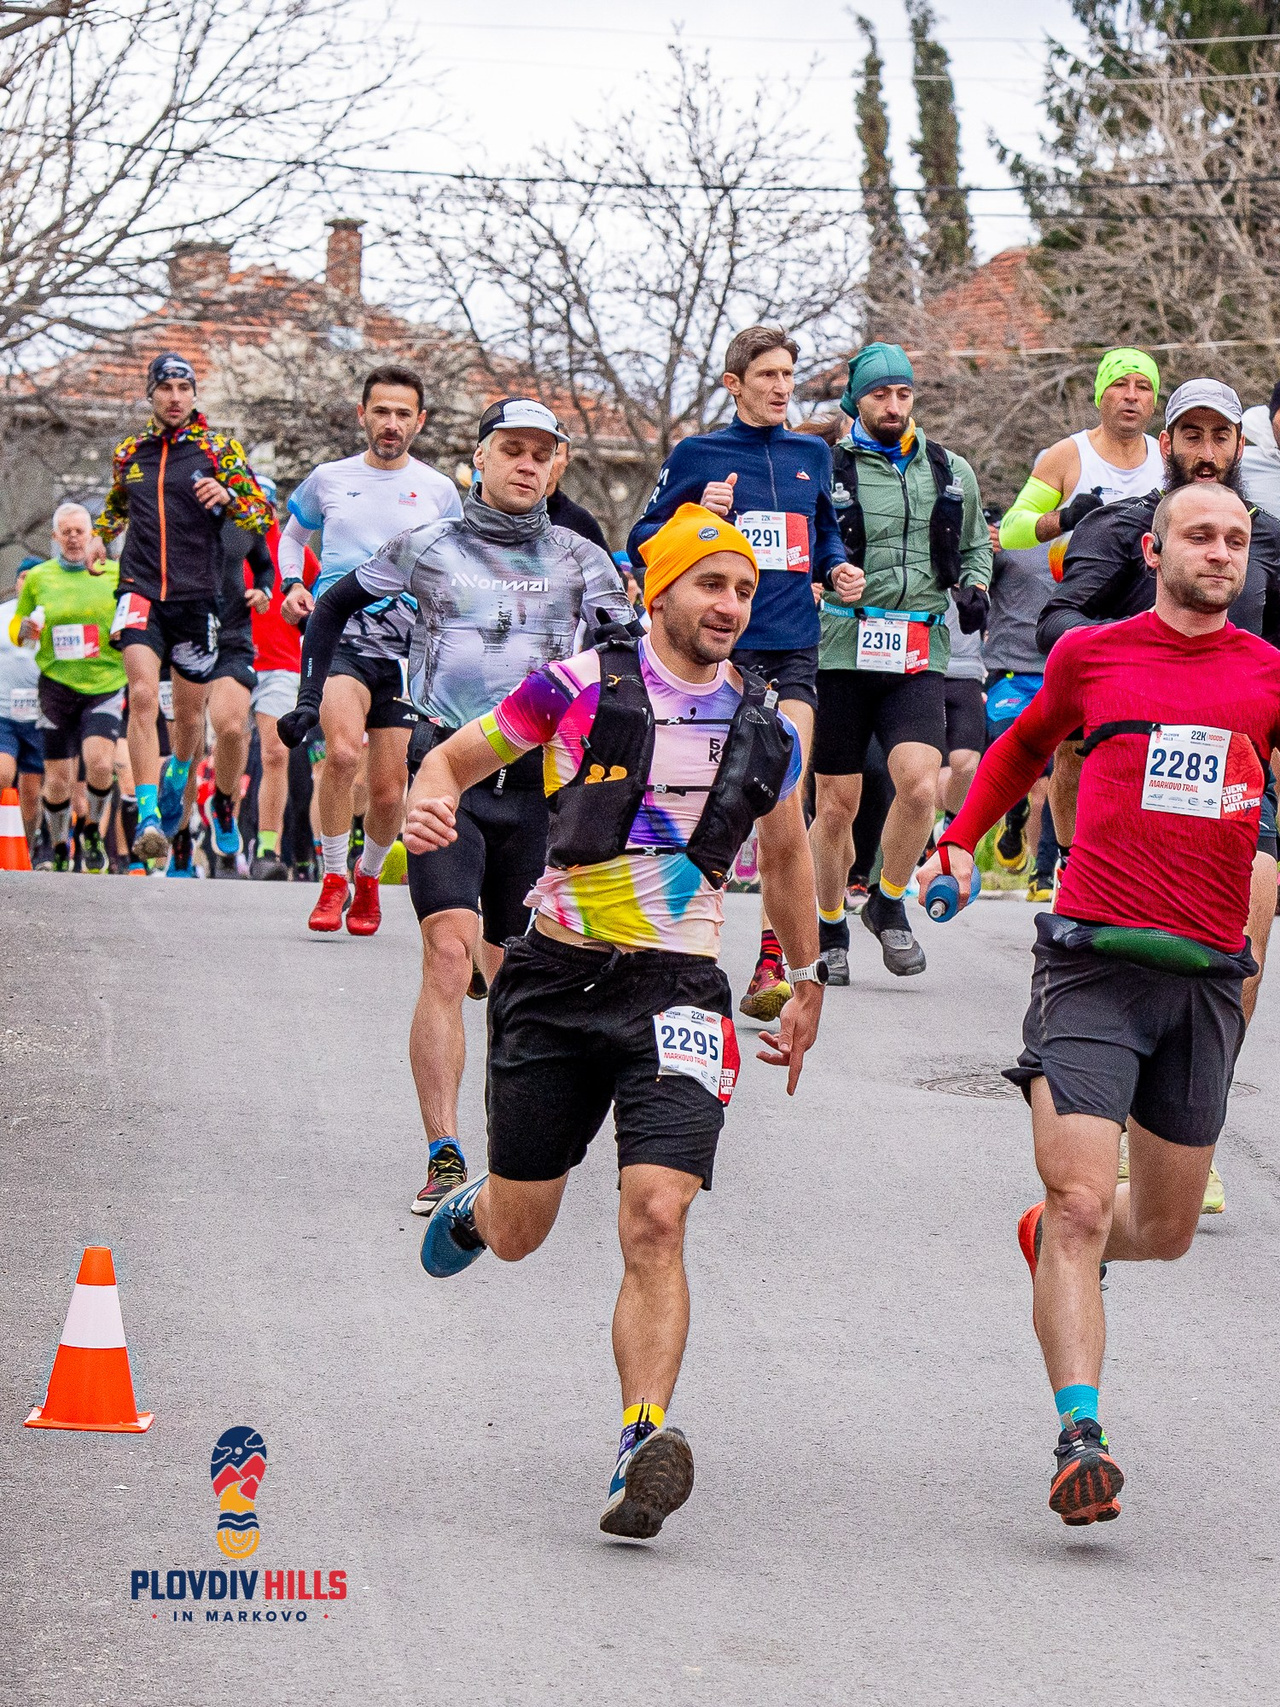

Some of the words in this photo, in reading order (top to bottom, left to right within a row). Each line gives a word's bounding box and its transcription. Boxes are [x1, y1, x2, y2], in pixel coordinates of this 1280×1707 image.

[862, 631, 902, 651] 2318
[1190, 730, 1208, 741] 22K
[1149, 748, 1220, 784] 2283
[1148, 779, 1182, 791] MARKOVO
[1182, 784, 1199, 793] TRAIL
[1222, 792, 1243, 804] STEP
[661, 1025, 719, 1061] 2295
[663, 1052, 694, 1063] MARKOVO
[694, 1056, 708, 1068] TRAIL
